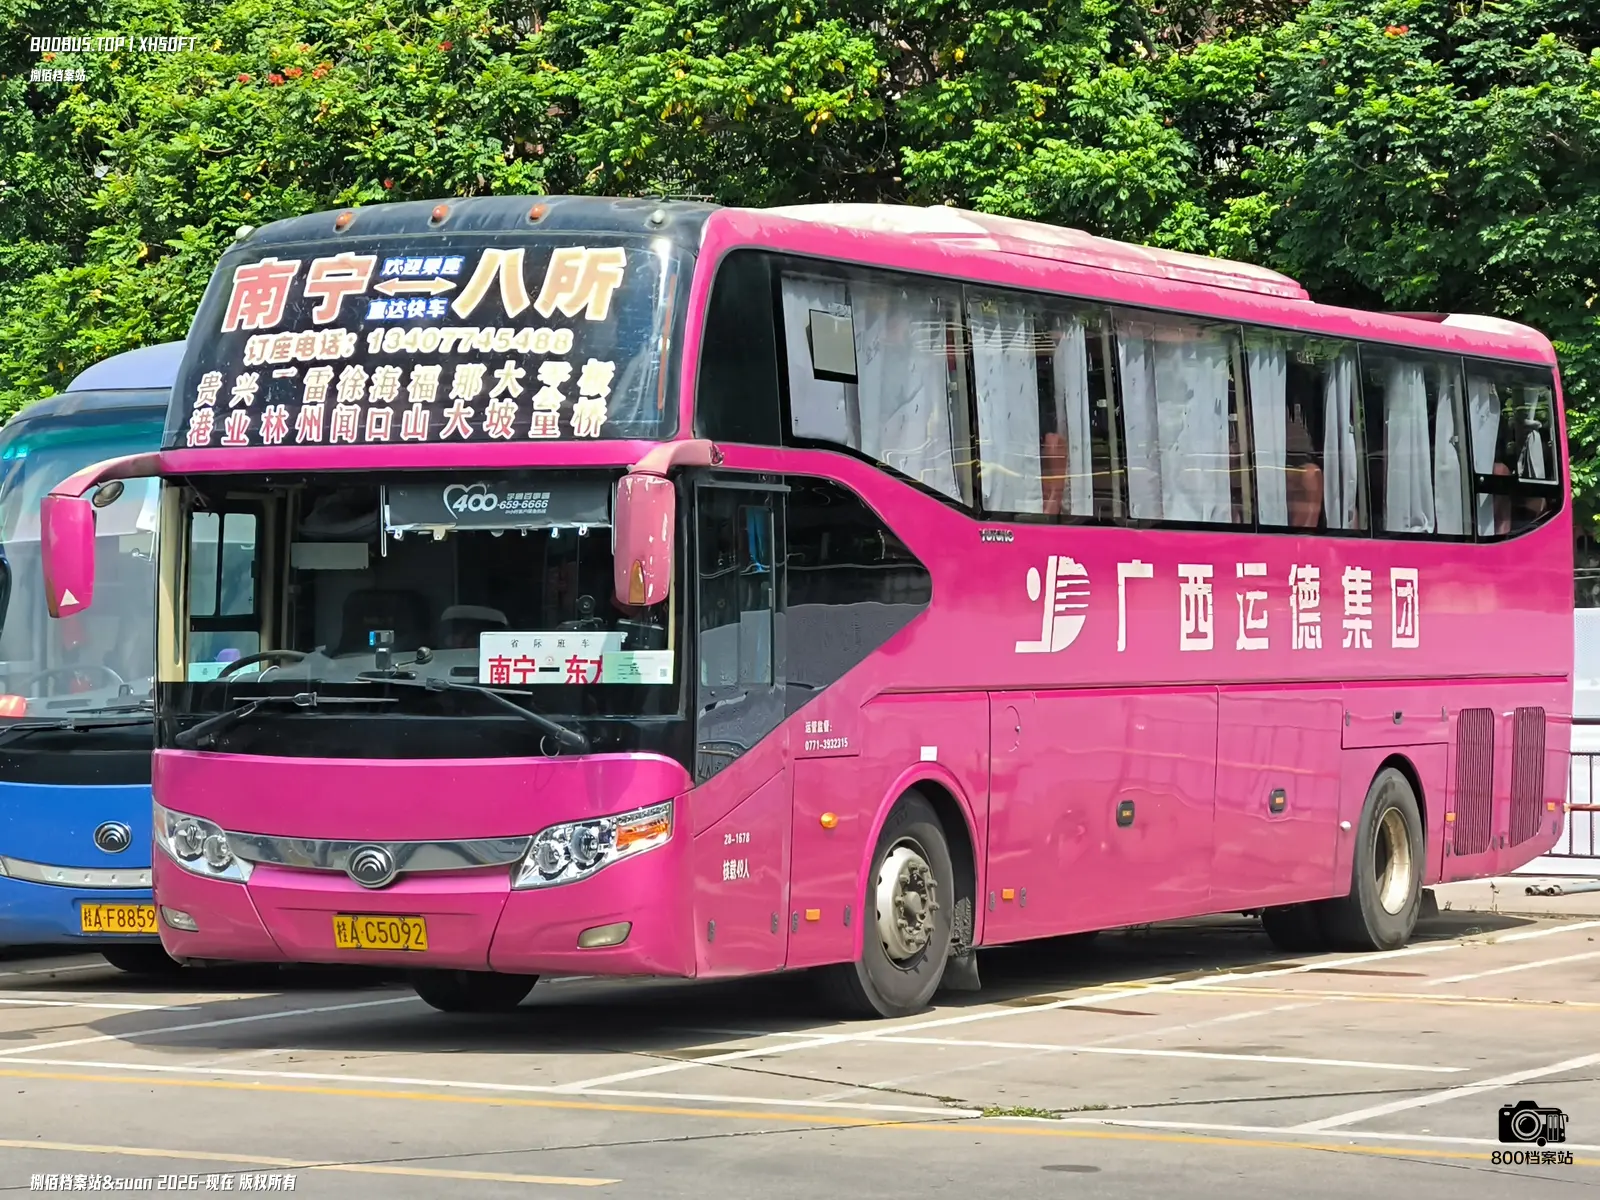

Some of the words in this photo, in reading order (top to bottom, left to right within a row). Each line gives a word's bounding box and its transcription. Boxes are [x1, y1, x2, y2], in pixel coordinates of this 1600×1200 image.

[221, 251, 377, 334] 南宁
[452, 246, 627, 321] 八所
[365, 297, 448, 320] 直达快车
[1116, 559, 1420, 652] 广西运德集团
[510, 639, 590, 649] 省际班车
[805, 737, 849, 751] 0771-3932315
[723, 832, 750, 845] 28-1678
[722, 858, 750, 881] 核载49人
